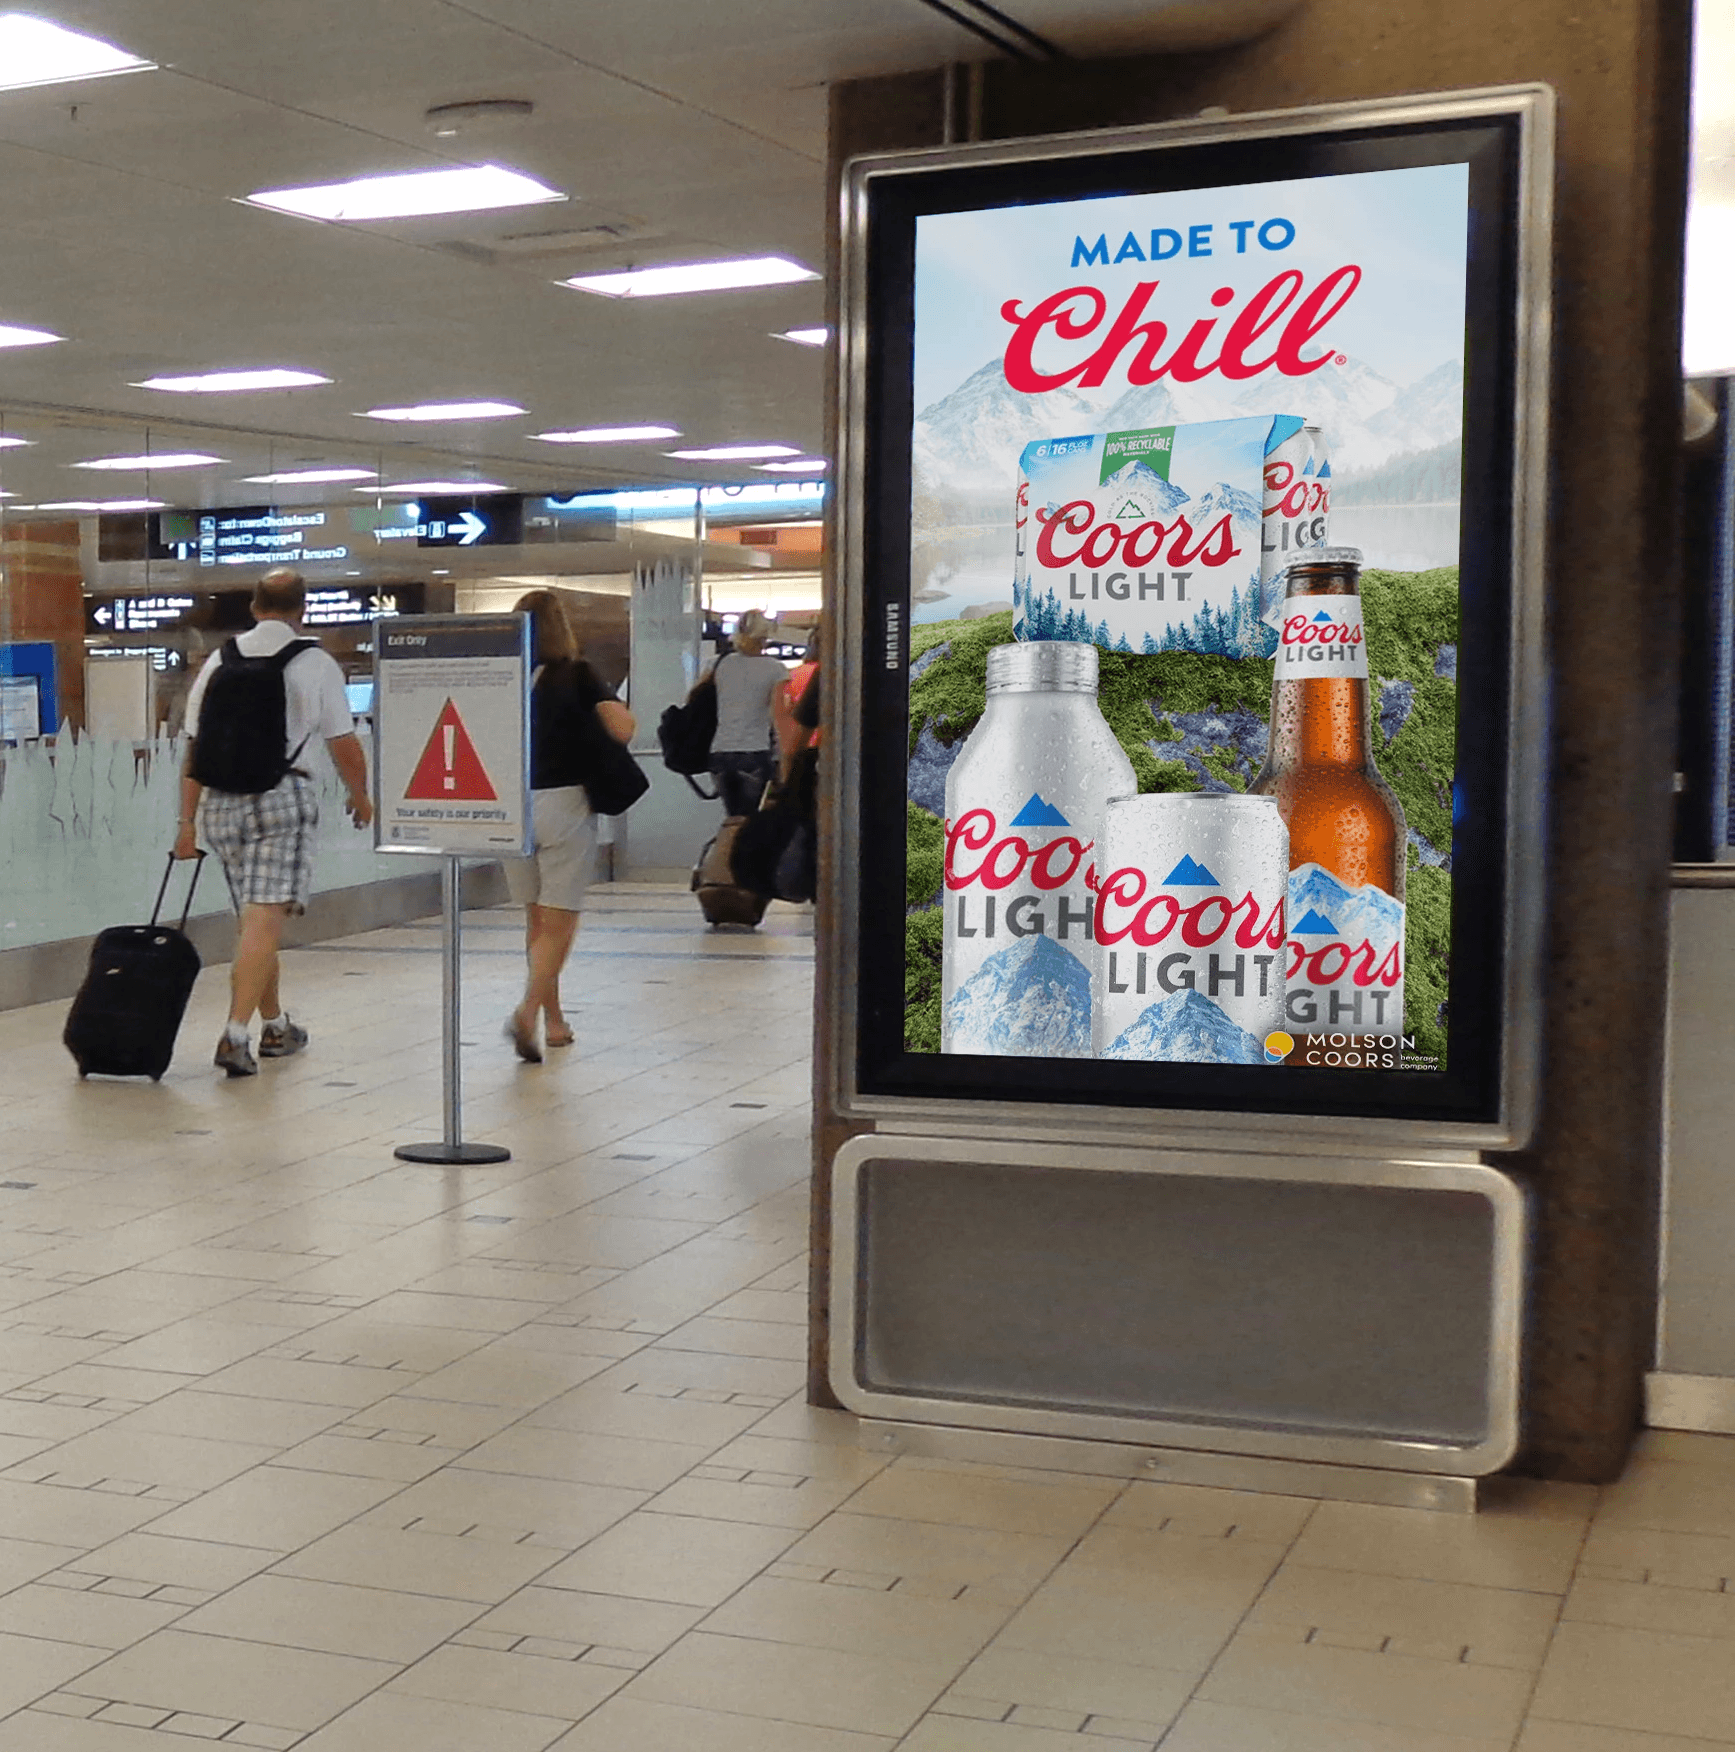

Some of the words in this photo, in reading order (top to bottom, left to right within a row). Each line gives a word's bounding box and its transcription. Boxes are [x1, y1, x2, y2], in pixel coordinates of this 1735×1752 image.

[1071, 224, 1213, 268] MADE
[1229, 217, 1296, 254] TO
[1000, 264, 1362, 394] Chill
[1106, 441, 1126, 457] 100%
[1127, 437, 1171, 451] RECYCLABLE
[1035, 499, 1242, 569] Coors
[1069, 571, 1193, 601] LIGHT
[886, 602, 899, 669] SAMSUNG
[1281, 614, 1363, 645] Coors
[1285, 644, 1357, 663] LIGHT
[943, 808, 1095, 891] Coo
[957, 895, 1094, 940] LIGH
[1093, 867, 1287, 950] Coors
[1108, 952, 1275, 997] LIGHT
[1285, 988, 1391, 1025] GHT
[1306, 1032, 1416, 1050] MOLSON
[1306, 1050, 1394, 1068] COORS
[1400, 1054, 1439, 1063] beverage
[1400, 1063, 1438, 1071] company
